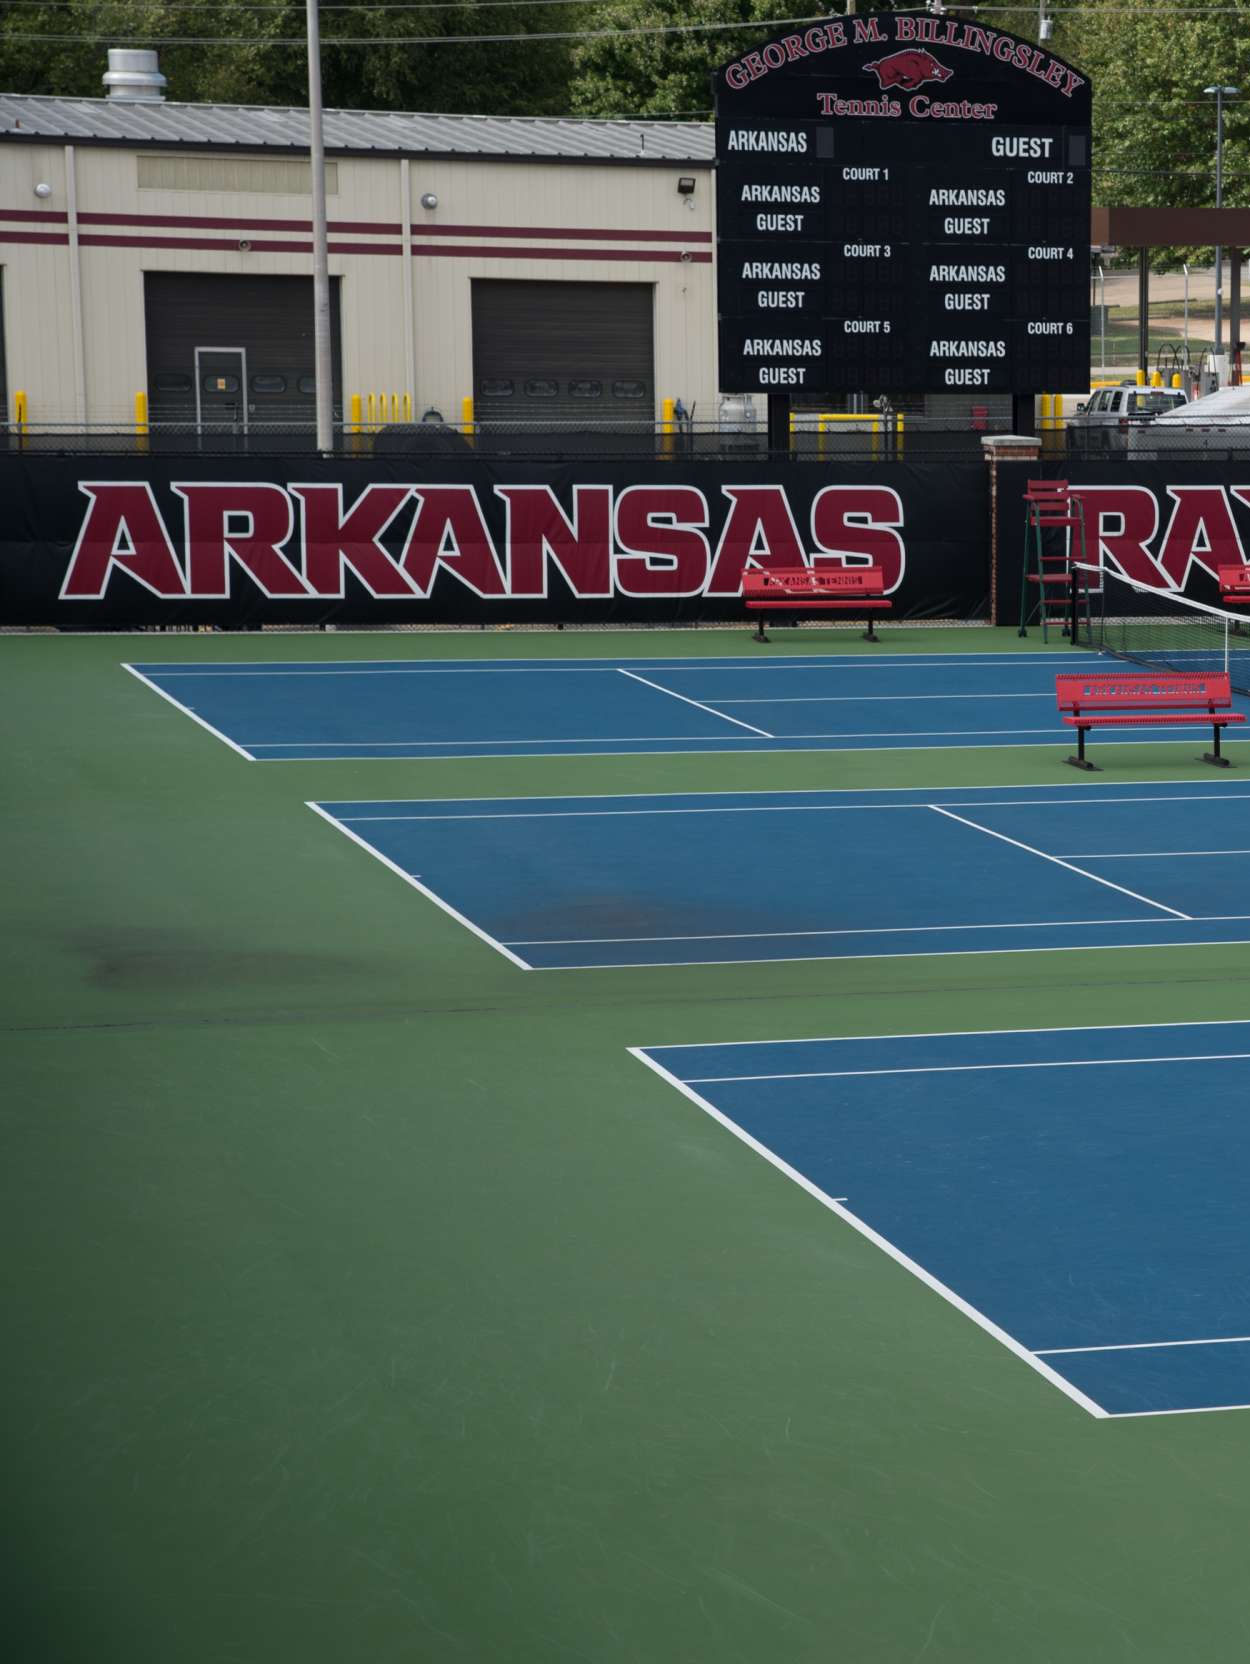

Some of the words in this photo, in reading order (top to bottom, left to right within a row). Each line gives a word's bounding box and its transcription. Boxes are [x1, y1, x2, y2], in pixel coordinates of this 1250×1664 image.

[725, 22, 849, 90] GEORGE
[853, 18, 888, 45] M.
[895, 16, 1085, 98] BILLINGSLEY
[817, 93, 901, 117] Tennis
[909, 96, 998, 119] Center
[727, 130, 807, 153] ARKANSAS
[991, 137, 1053, 158] GUEST
[842, 168, 879, 181] COURT
[883, 168, 889, 180] 1
[1027, 171, 1064, 184] COURT
[1067, 171, 1074, 184] 2
[741, 186, 820, 203] ARKANSAS
[929, 189, 1005, 206] ARKANSAS
[756, 214, 804, 231] GUEST
[944, 218, 990, 234] GUEST
[844, 244, 880, 257] COURT
[884, 244, 891, 257] 3
[1028, 247, 1064, 260] COURT
[1067, 247, 1074, 259] 4
[742, 263, 821, 280] ARKANSAS
[929, 265, 1005, 282] ARKANSAS
[757, 291, 805, 308] GUEST
[944, 294, 990, 310] GUEST
[844, 321, 880, 333] COURT
[883, 321, 890, 333] 5
[1027, 322, 1064, 335] COURT
[1067, 322, 1073, 335] 6
[743, 339, 822, 356] ARKANSAS
[929, 341, 1006, 358] ARKANSAS
[759, 368, 806, 384] GUEST
[944, 369, 990, 385] GUEST
[58, 481, 906, 600] ARKANSAS
